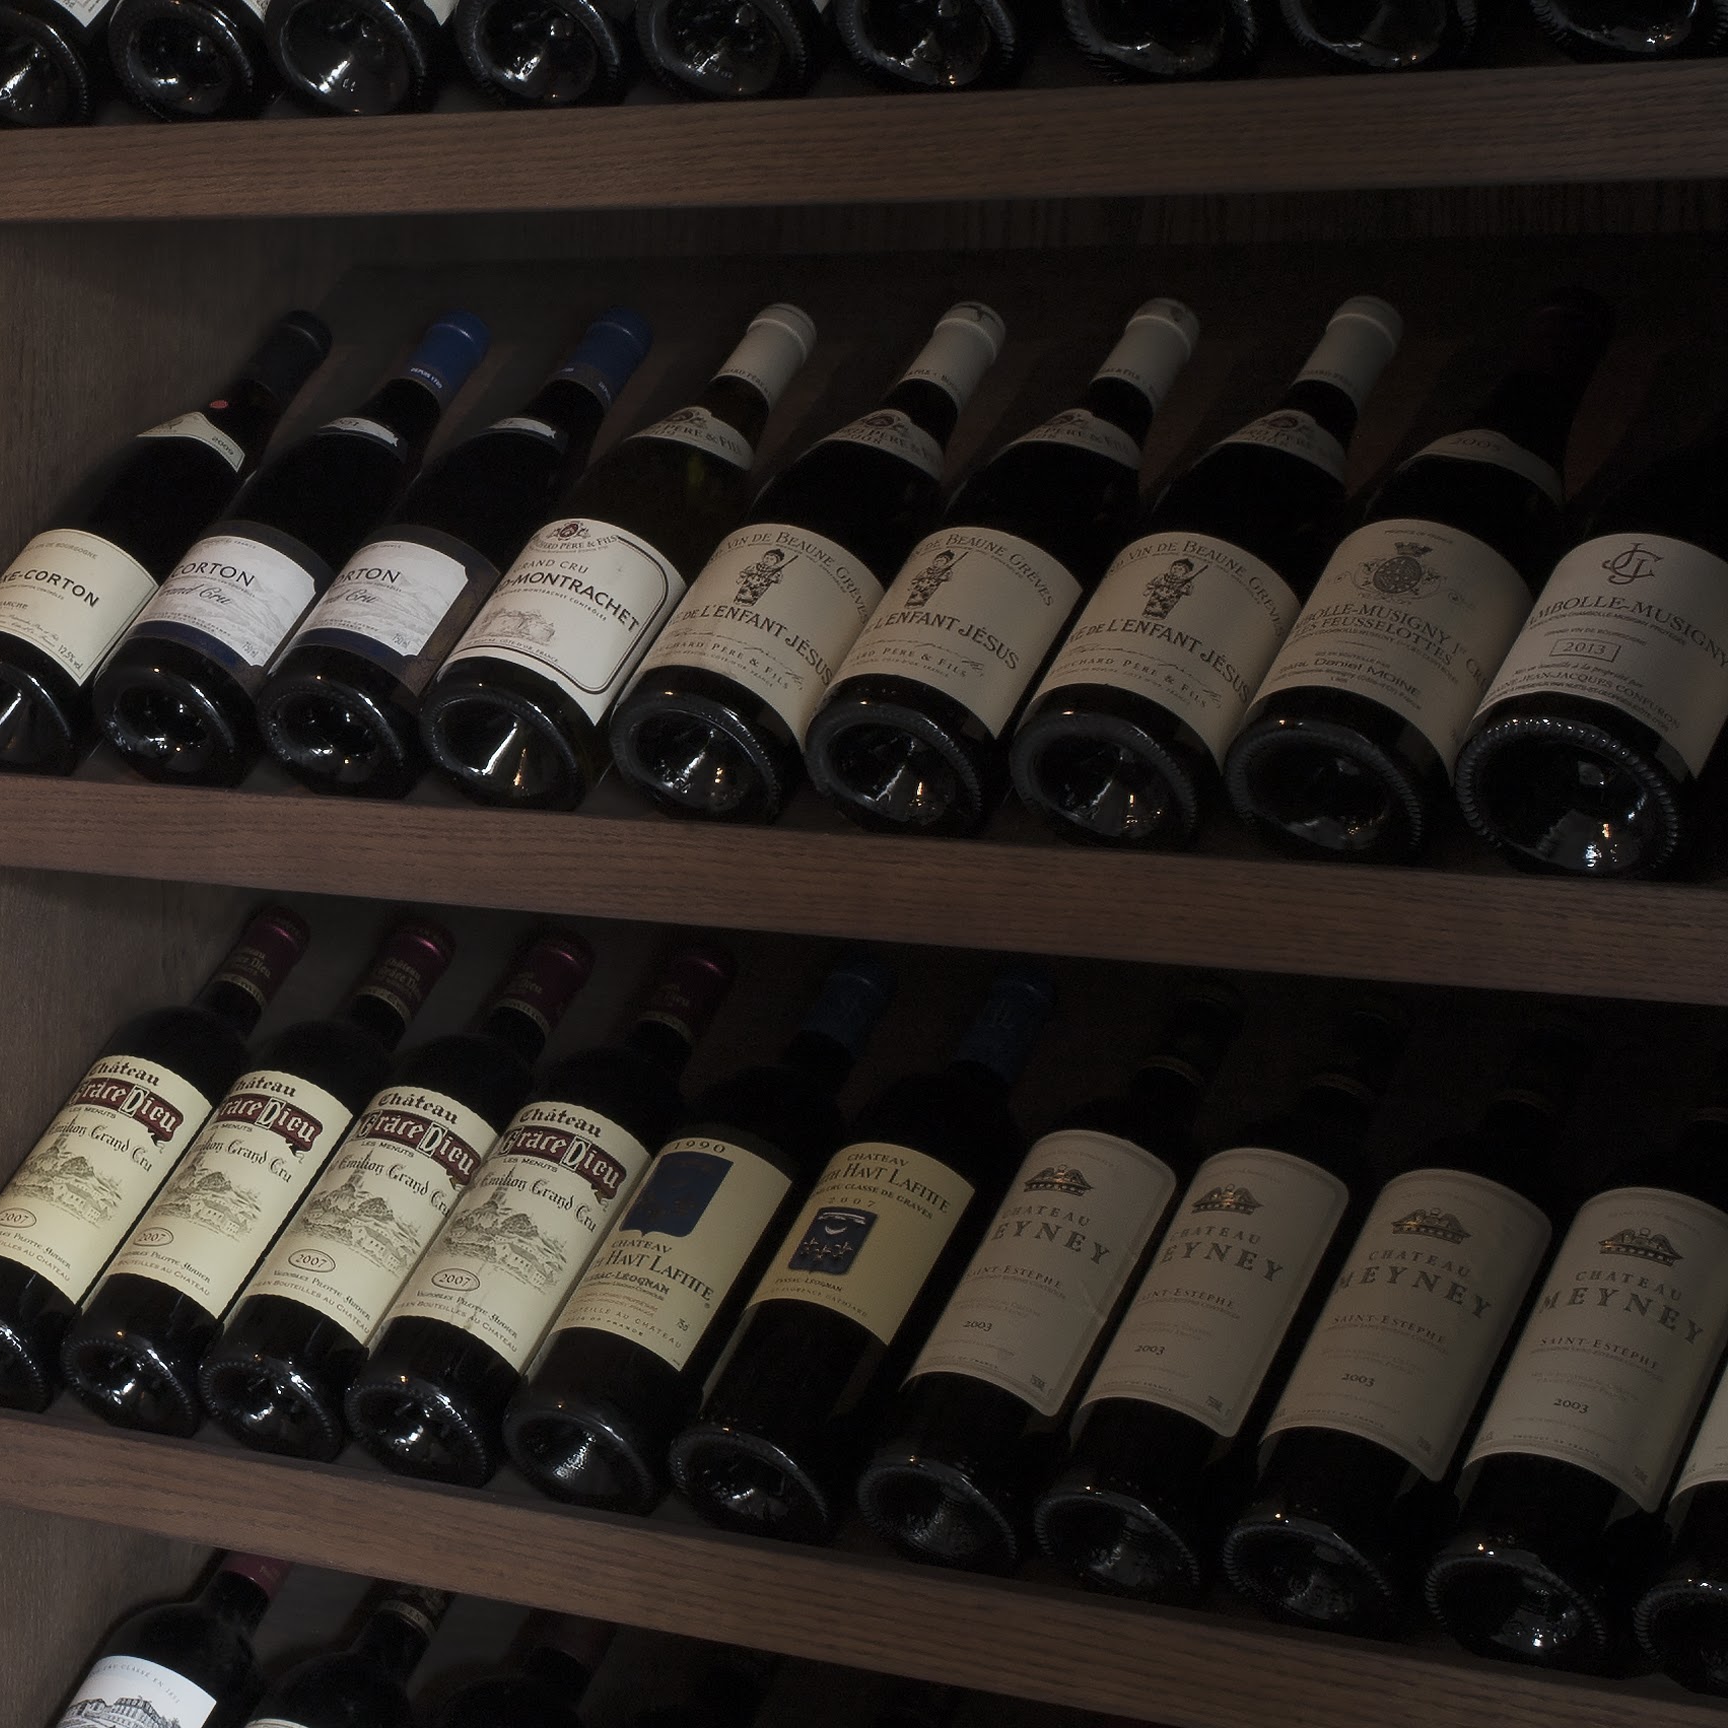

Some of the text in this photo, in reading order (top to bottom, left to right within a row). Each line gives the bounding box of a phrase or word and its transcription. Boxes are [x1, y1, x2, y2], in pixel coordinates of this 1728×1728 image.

[1562, 641, 1607, 656] 2013
[0, 1212, 28, 1224] 2007
[295, 1254, 329, 1269] 2007
[438, 1272, 471, 1287] 2007
